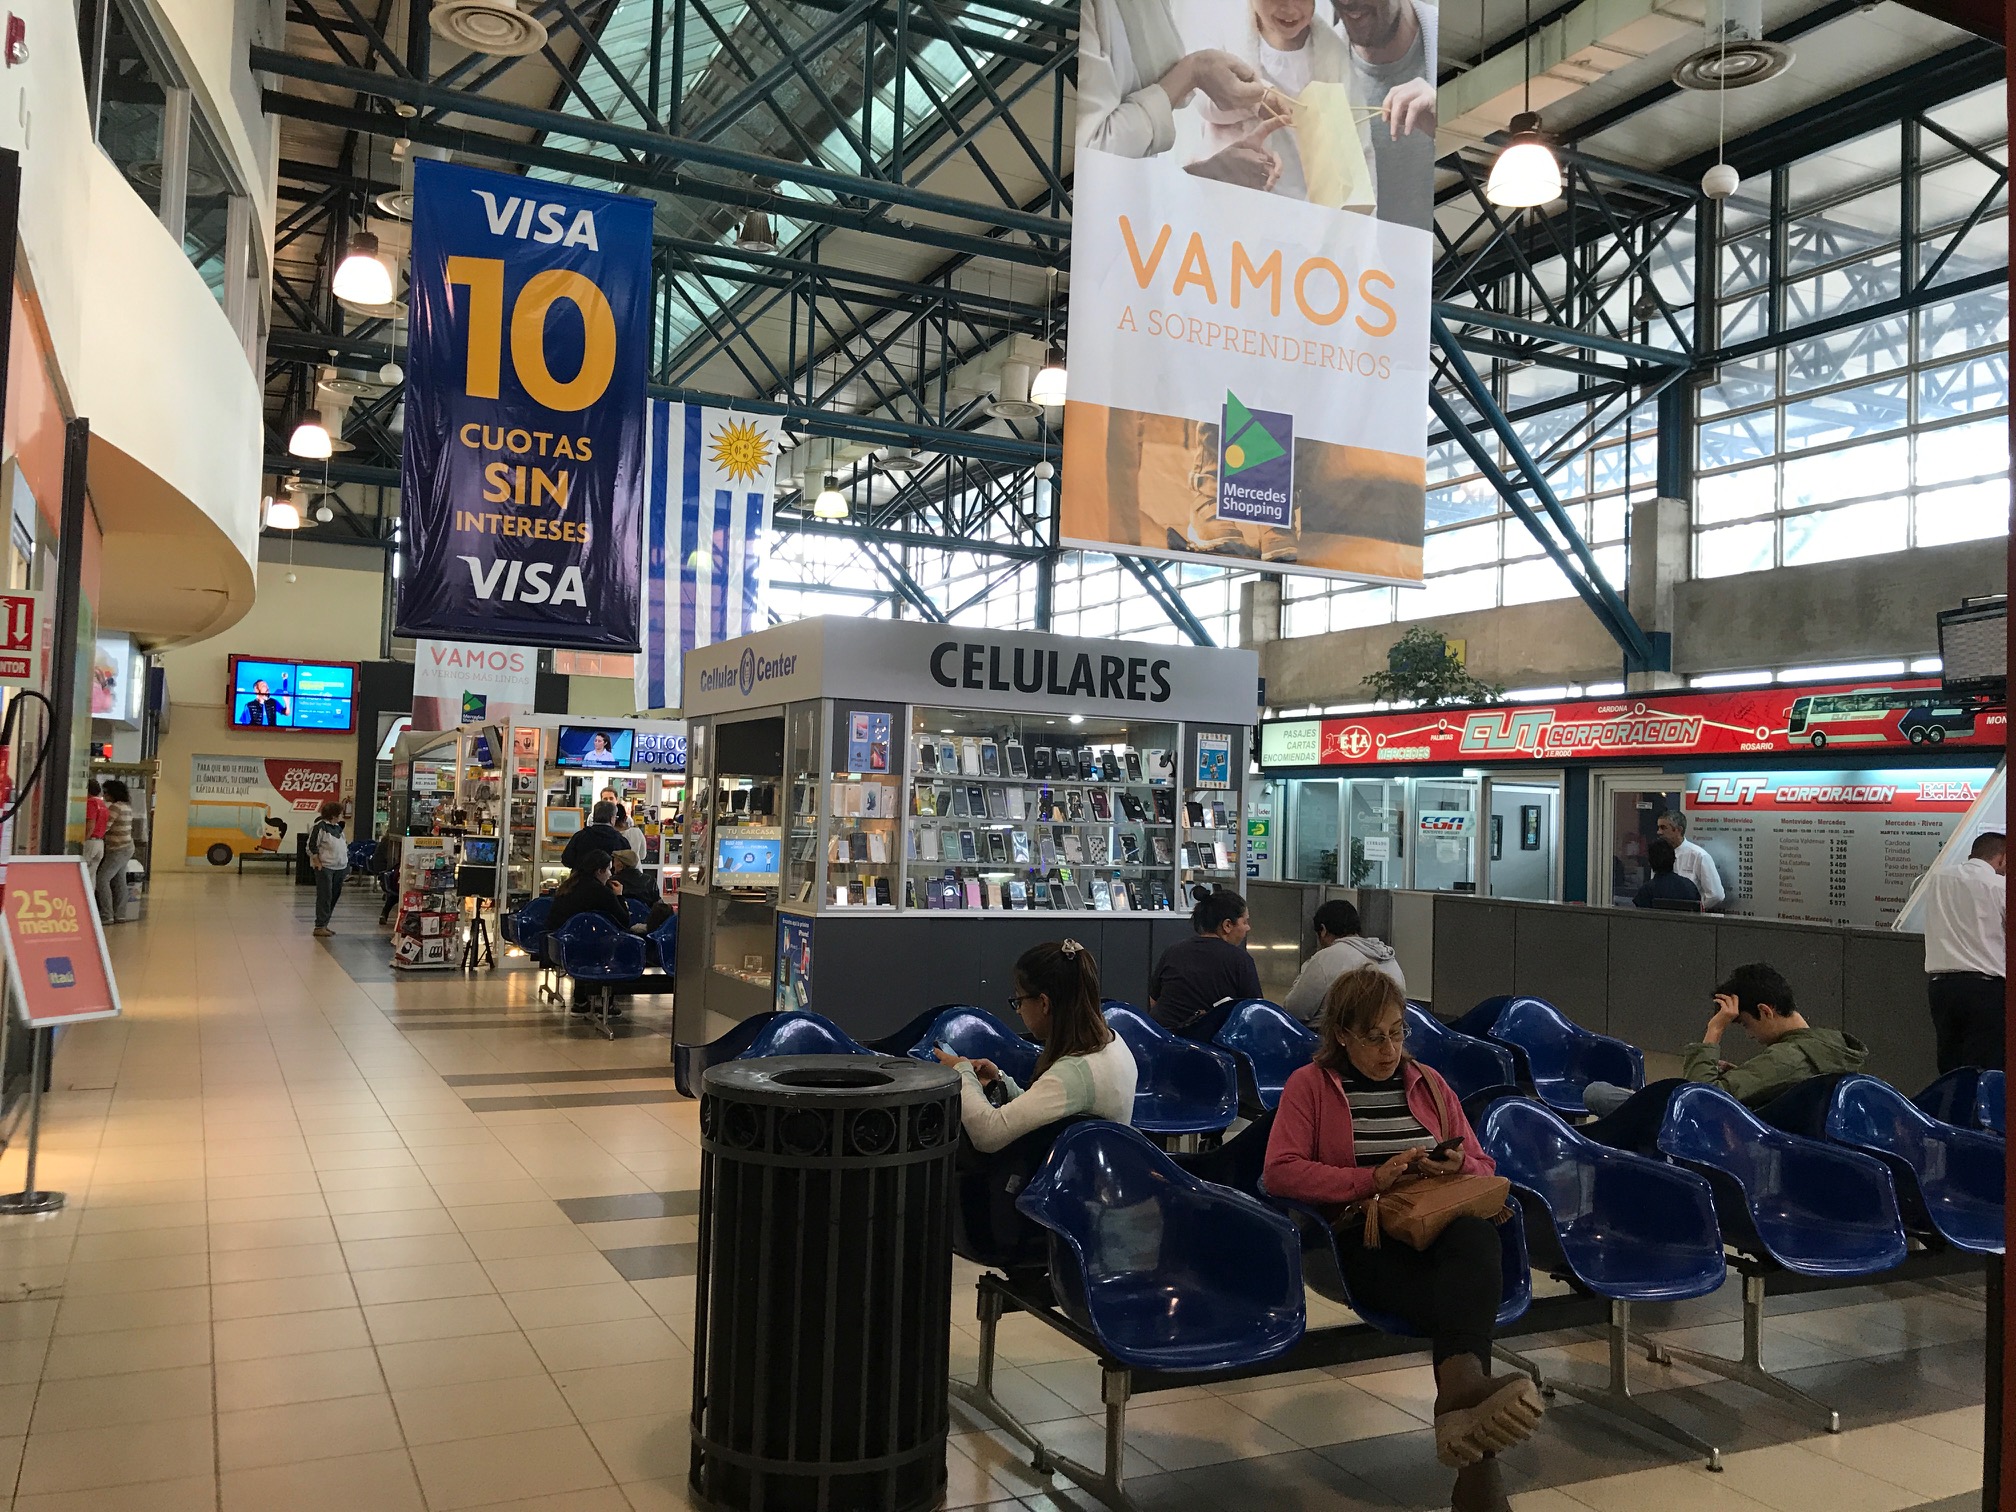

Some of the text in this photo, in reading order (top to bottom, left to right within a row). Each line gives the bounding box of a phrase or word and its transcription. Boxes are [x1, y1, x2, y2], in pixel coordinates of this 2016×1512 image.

[471, 189, 599, 252] VISA
[1118, 214, 1397, 338] VAMOS
[448, 255, 617, 412] 10
[1117, 306, 1391, 380] A SORPRENDERNOS
[459, 423, 593, 462] CUOTAS
[482, 462, 569, 510] SIN
[1223, 483, 1287, 504] Mercedes
[1222, 497, 1282, 520] Shopping
[456, 510, 591, 544] INTERESES
[456, 555, 587, 607] VISA
[430, 646, 525, 673] VAMOS
[421, 668, 429, 677] A
[431, 669, 471, 680] VERNOS
[493, 674, 531, 685] LINDAS
[700, 653, 798, 692] Cellular Center
[930, 641, 1172, 703] CELULARES
[1598, 704, 1628, 713] CARDONA
[1282, 727, 1317, 740] PASAJES
[1429, 733, 1454, 741] PALMITAS
[1547, 718, 1702, 748] CORPORACION
[1285, 740, 1317, 751] CARTAS
[1376, 746, 1431, 761] MERCEDES
[1740, 742, 1774, 751] ROSARIO
[197, 762, 210, 772] PARA
[222, 764, 231, 772] NO
[1262, 751, 1317, 763] ENCOMIENDAS
[238, 776, 259, 784] COMPRA
[284, 771, 339, 783] COMPRA
[1775, 784, 1897, 804] CORPORACION
[12, 889, 76, 919] 25%
[18, 917, 79, 935] menos
